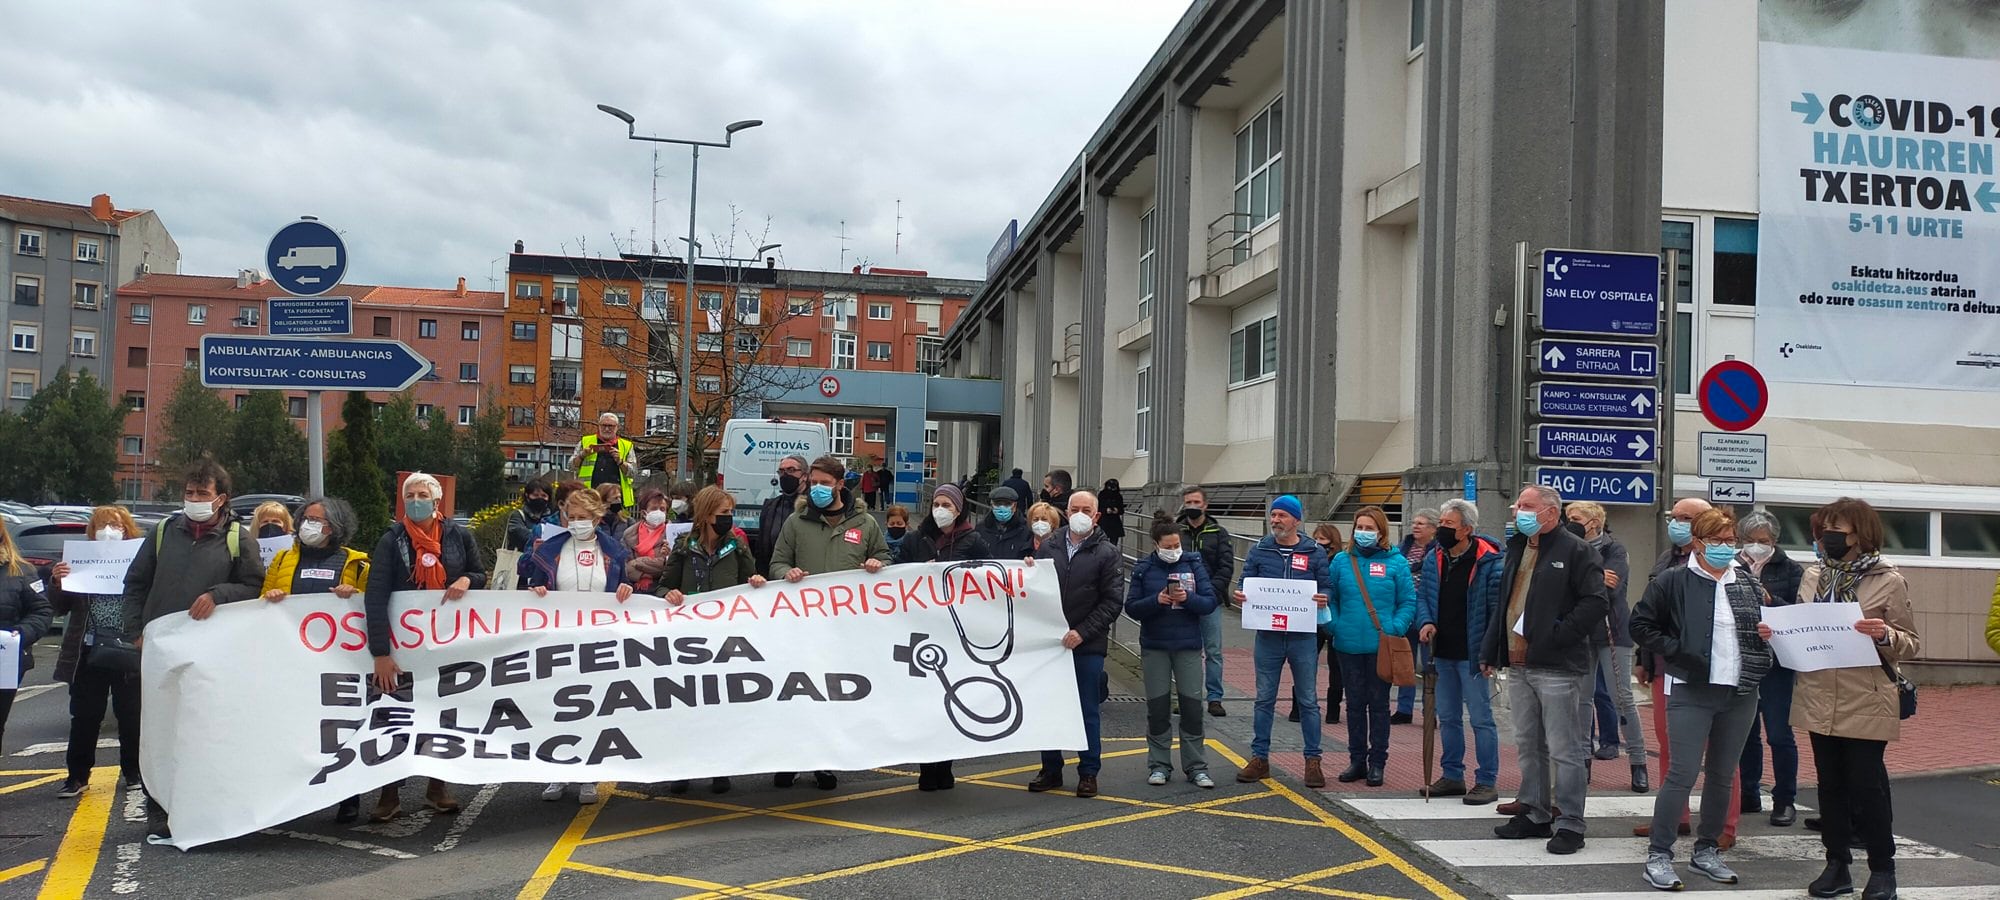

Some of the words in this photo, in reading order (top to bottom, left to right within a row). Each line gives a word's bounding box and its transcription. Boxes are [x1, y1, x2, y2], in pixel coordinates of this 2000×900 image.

[1813, 131, 1993, 175] HAURREN
[1800, 168, 1972, 212] TXERTOA
[1849, 213, 1898, 235] 5-11
[1907, 216, 1963, 239] URTE
[1851, 265, 1893, 280] Eskatu
[1896, 267, 1958, 284] hitzordua
[1545, 287, 1567, 298] SAN
[1570, 289, 1597, 300] ELOY
[1599, 290, 1654, 303] OSPITALEA
[1832, 280, 1928, 297] osakidetza.eus
[1931, 286, 1976, 299] atarian
[1800, 292, 1823, 305] edo
[1826, 295, 1855, 307] zure
[1858, 297, 1904, 310] osasun
[1906, 299, 1960, 313] zentrora
[208, 345, 301, 358] ANBULANTZIAK
[310, 349, 393, 360] AMBULANCIAS
[1575, 347, 1621, 359] SARRERA
[209, 367, 289, 379] KONTSULTAK
[298, 369, 366, 380] CONSULTAS
[1576, 360, 1620, 372] ENTRADA
[1543, 390, 1570, 399] KANPO
[1579, 392, 1627, 402] KONTSULTAK
[1543, 402, 1586, 412] CONSULTAS
[1588, 404, 1628, 414] EXTERNAS
[758, 439, 810, 451] ORTOVÁS
[1547, 431, 1617, 444] LARRIALDIAK
[1551, 444, 1613, 457] URGENCIAS
[1541, 474, 1576, 494] EAG
[1590, 477, 1622, 495] PAC
[769, 568, 1028, 619] ARRISKUAN!
[1252, 604, 1309, 613] PRESENCIALIDAD
[320, 671, 414, 706] EN
[438, 636, 765, 697] DEFENSA
[320, 706, 415, 754] DE
[439, 698, 533, 735] LA
[553, 671, 872, 723] SANIDAD
[308, 727, 643, 785] PÚBLICA
